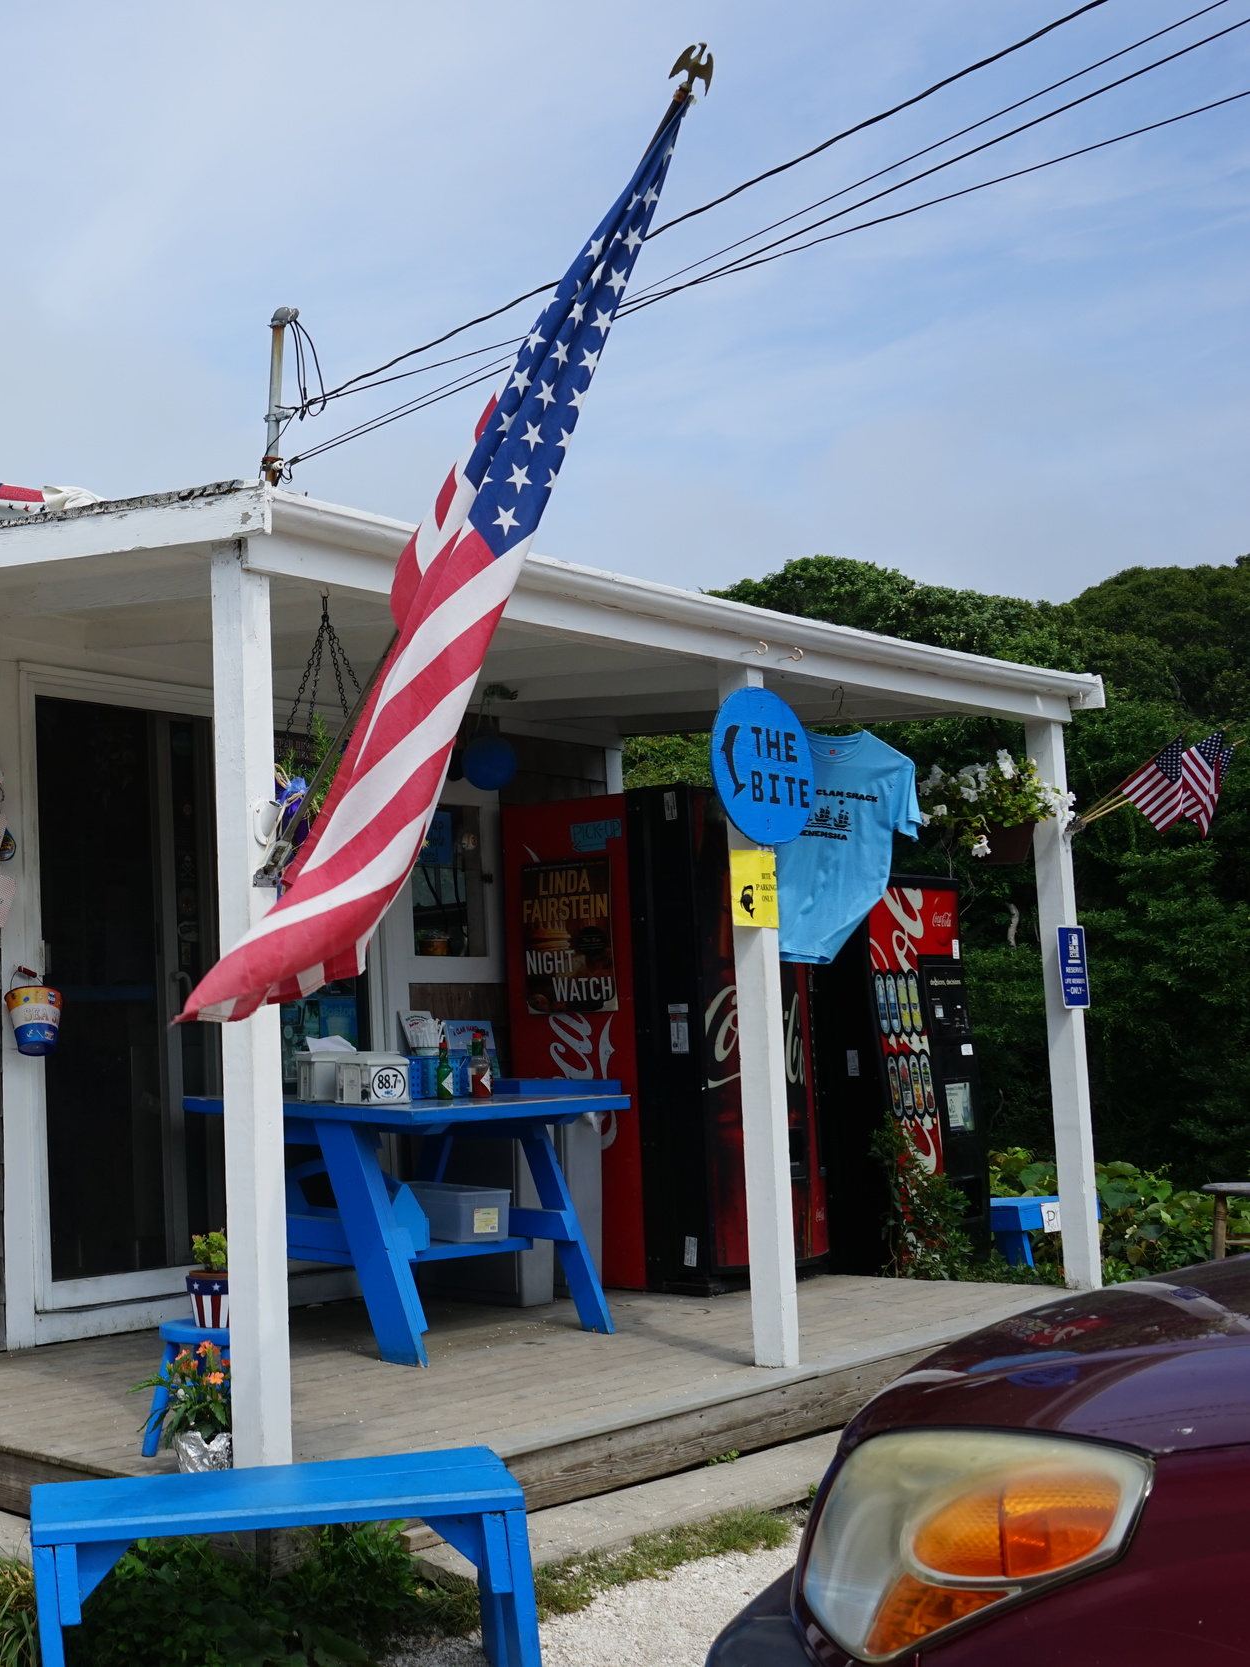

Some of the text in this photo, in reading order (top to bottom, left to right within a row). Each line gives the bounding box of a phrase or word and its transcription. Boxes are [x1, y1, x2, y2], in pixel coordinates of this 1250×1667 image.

[751, 726, 798, 763] THE
[751, 771, 811, 809] BITE
[816, 788, 879, 803] CLAM SHACK
[572, 820, 621, 841] PICK-UP
[538, 868, 591, 896] LINDA
[761, 872, 771, 880] BITE
[756, 883, 777, 892] PARKING
[762, 895, 774, 903] ONLY
[522, 893, 608, 924] FAIRSTEIN
[932, 911, 953, 928] Coca-Cola
[525, 950, 575, 976] NIGHT
[552, 976, 613, 1002] WATCH
[23, 1007, 50, 1022] SEA
[320, 1006, 356, 1017] Boston
[377, 1073, 398, 1089] 88.7
